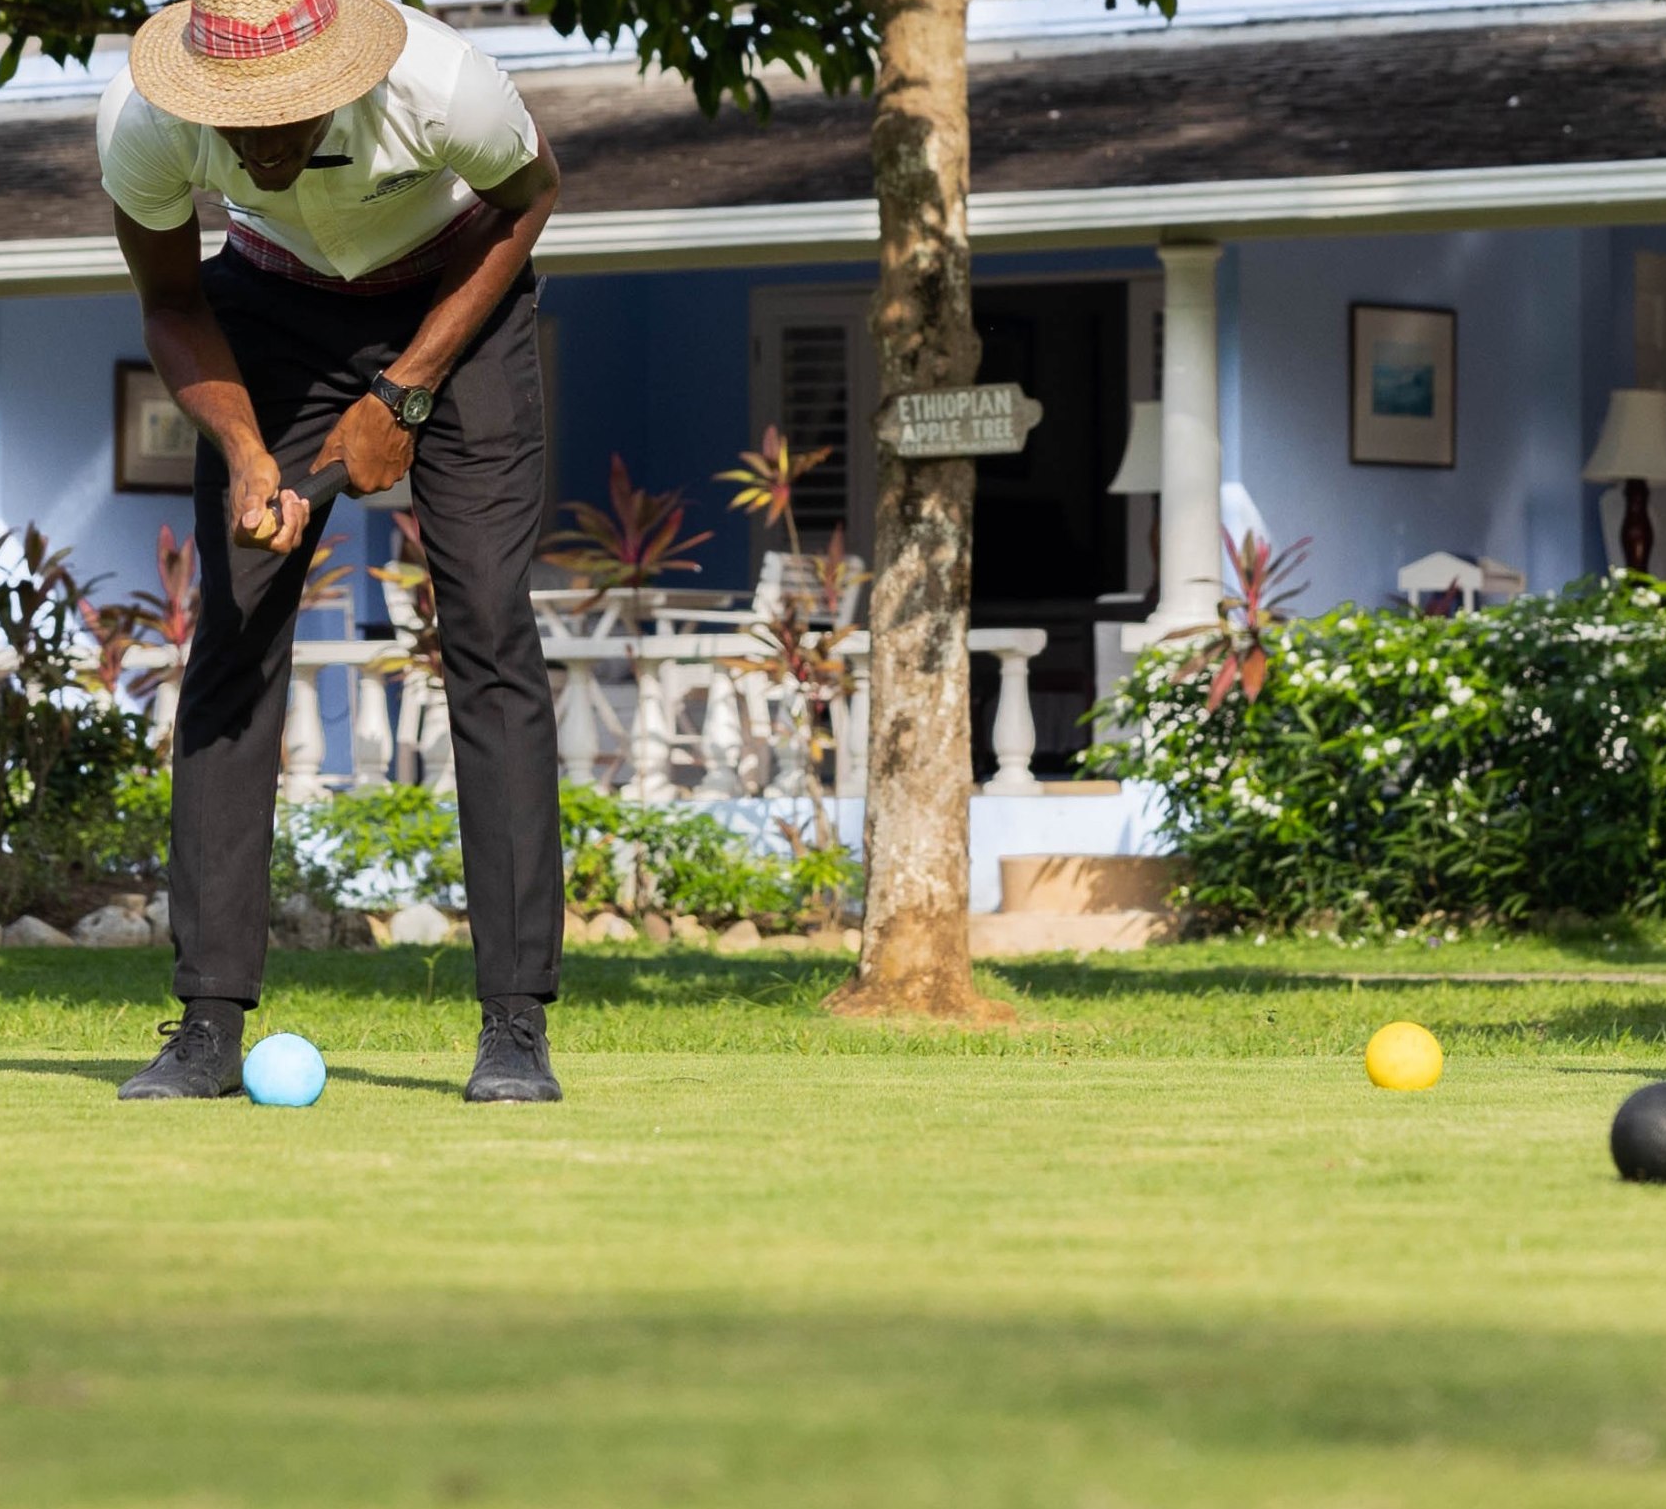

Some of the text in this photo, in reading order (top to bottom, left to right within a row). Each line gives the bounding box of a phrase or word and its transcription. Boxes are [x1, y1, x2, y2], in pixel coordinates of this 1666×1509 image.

[898, 389, 1011, 422] ETHIOPIAN
[900, 416, 1014, 444] APPLE TREE
